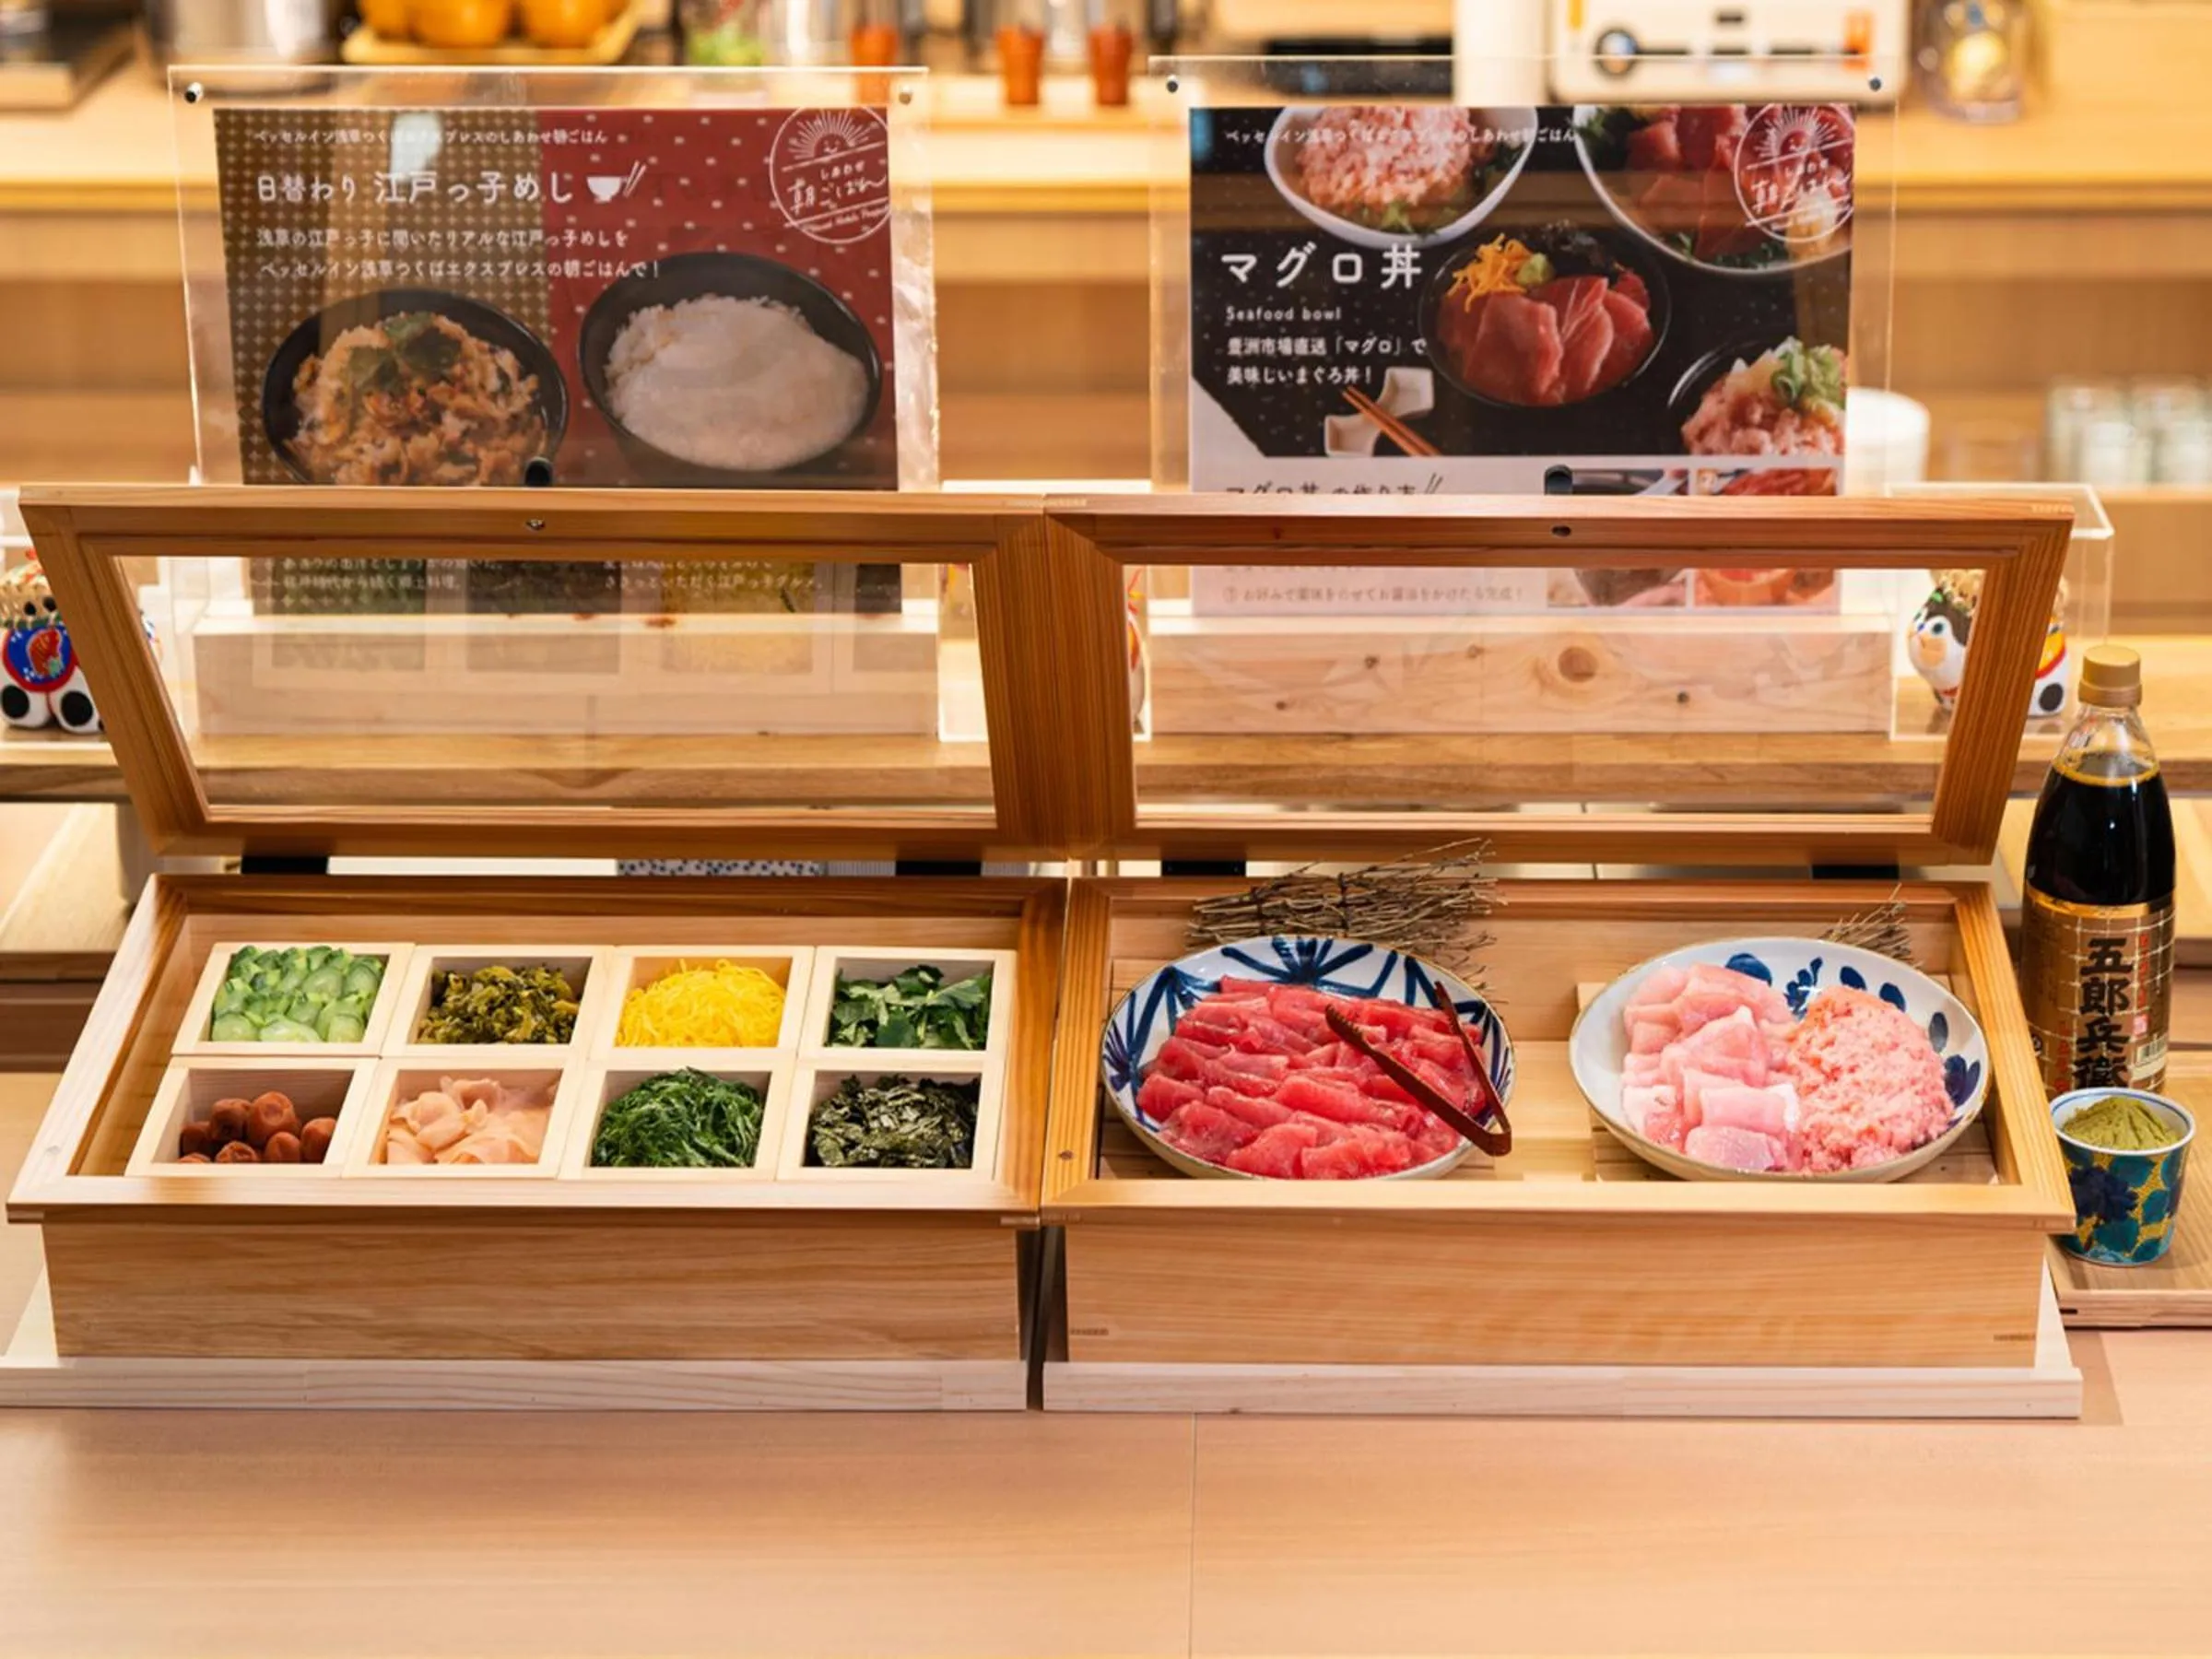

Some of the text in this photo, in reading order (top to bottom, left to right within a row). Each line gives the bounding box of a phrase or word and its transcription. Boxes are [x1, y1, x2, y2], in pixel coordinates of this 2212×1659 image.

[257, 170, 573, 205] 日替わり 江戸っ子めし
[1221, 241, 1422, 289] マグロ丼
[1226, 306, 1342, 321] Seafood bowl
